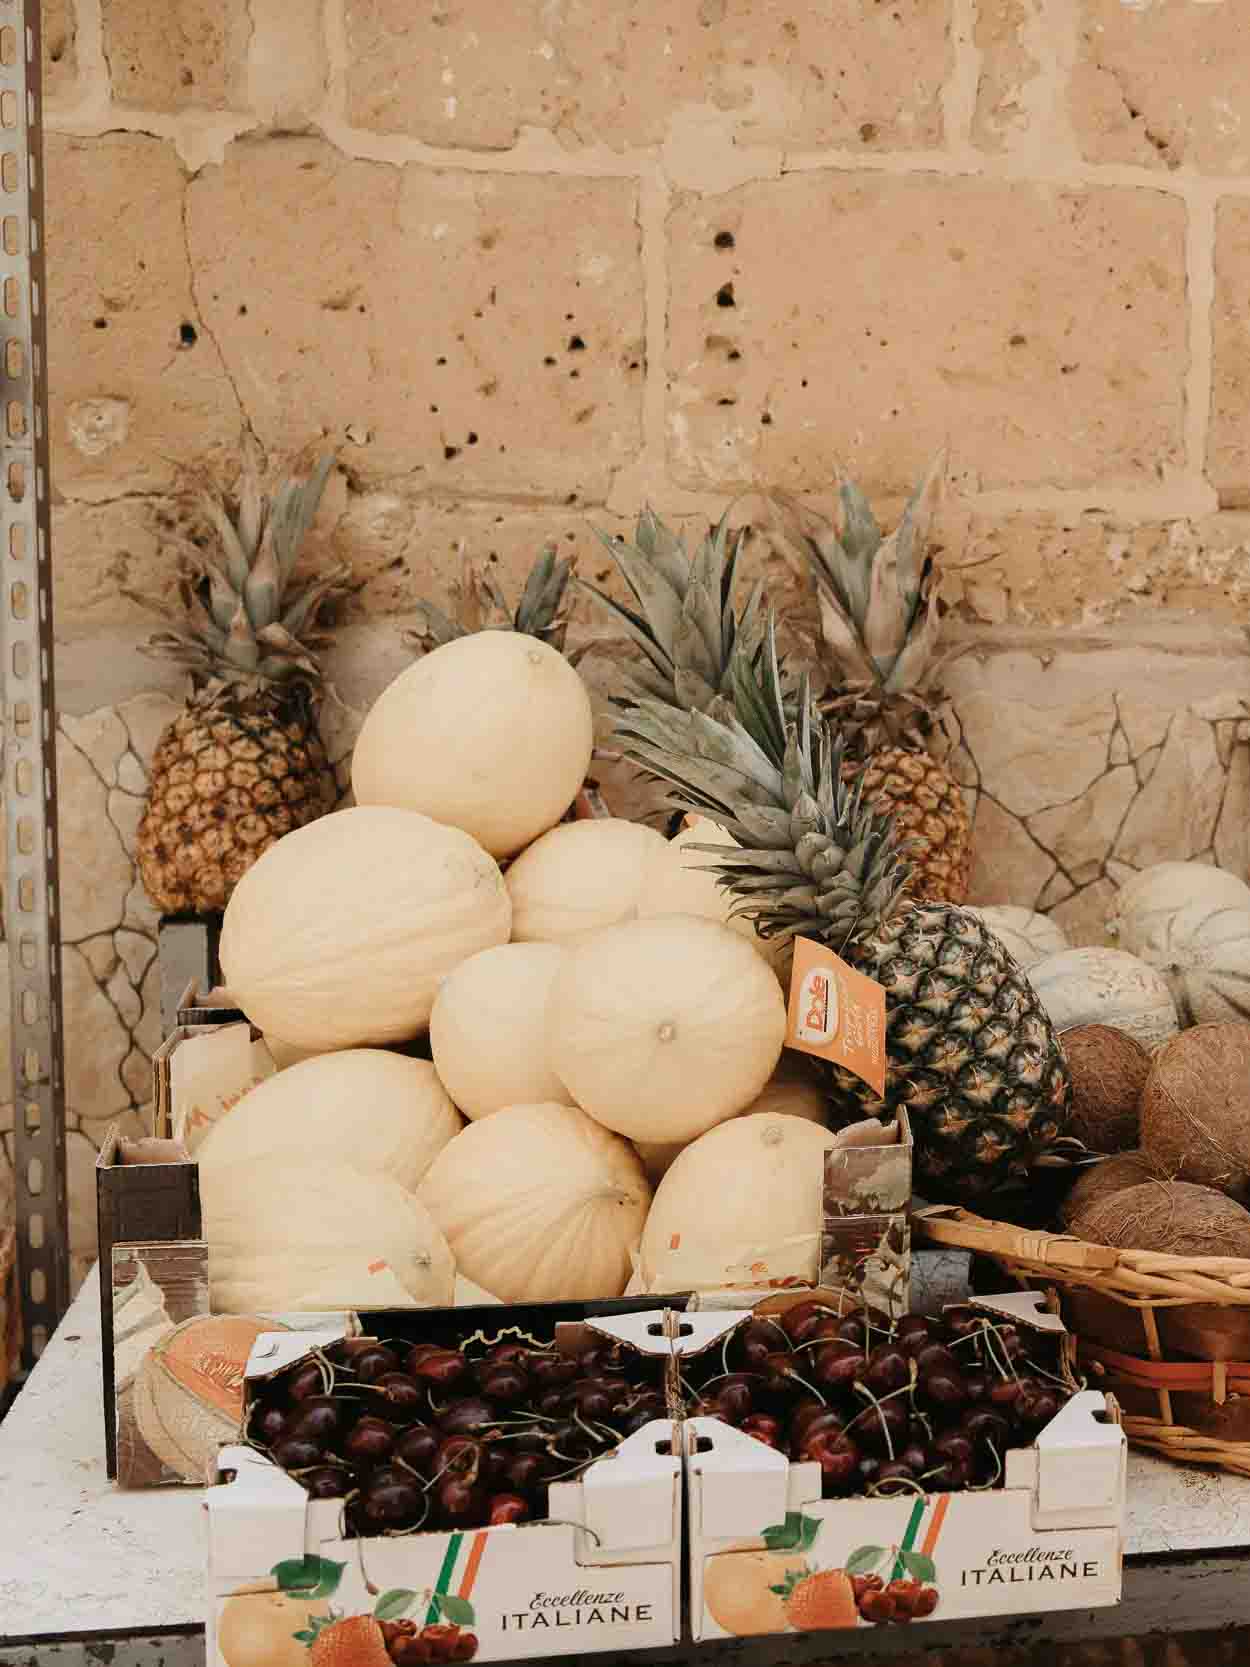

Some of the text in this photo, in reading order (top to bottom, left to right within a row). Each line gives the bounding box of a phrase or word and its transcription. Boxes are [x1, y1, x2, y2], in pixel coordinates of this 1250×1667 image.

[804, 975, 825, 1032] Dole
[986, 1546, 1074, 1567] Eccellenze
[961, 1561, 1099, 1587] ITALIANE
[529, 1589, 625, 1610] Eccellenze
[501, 1604, 653, 1631] ITALIANE
